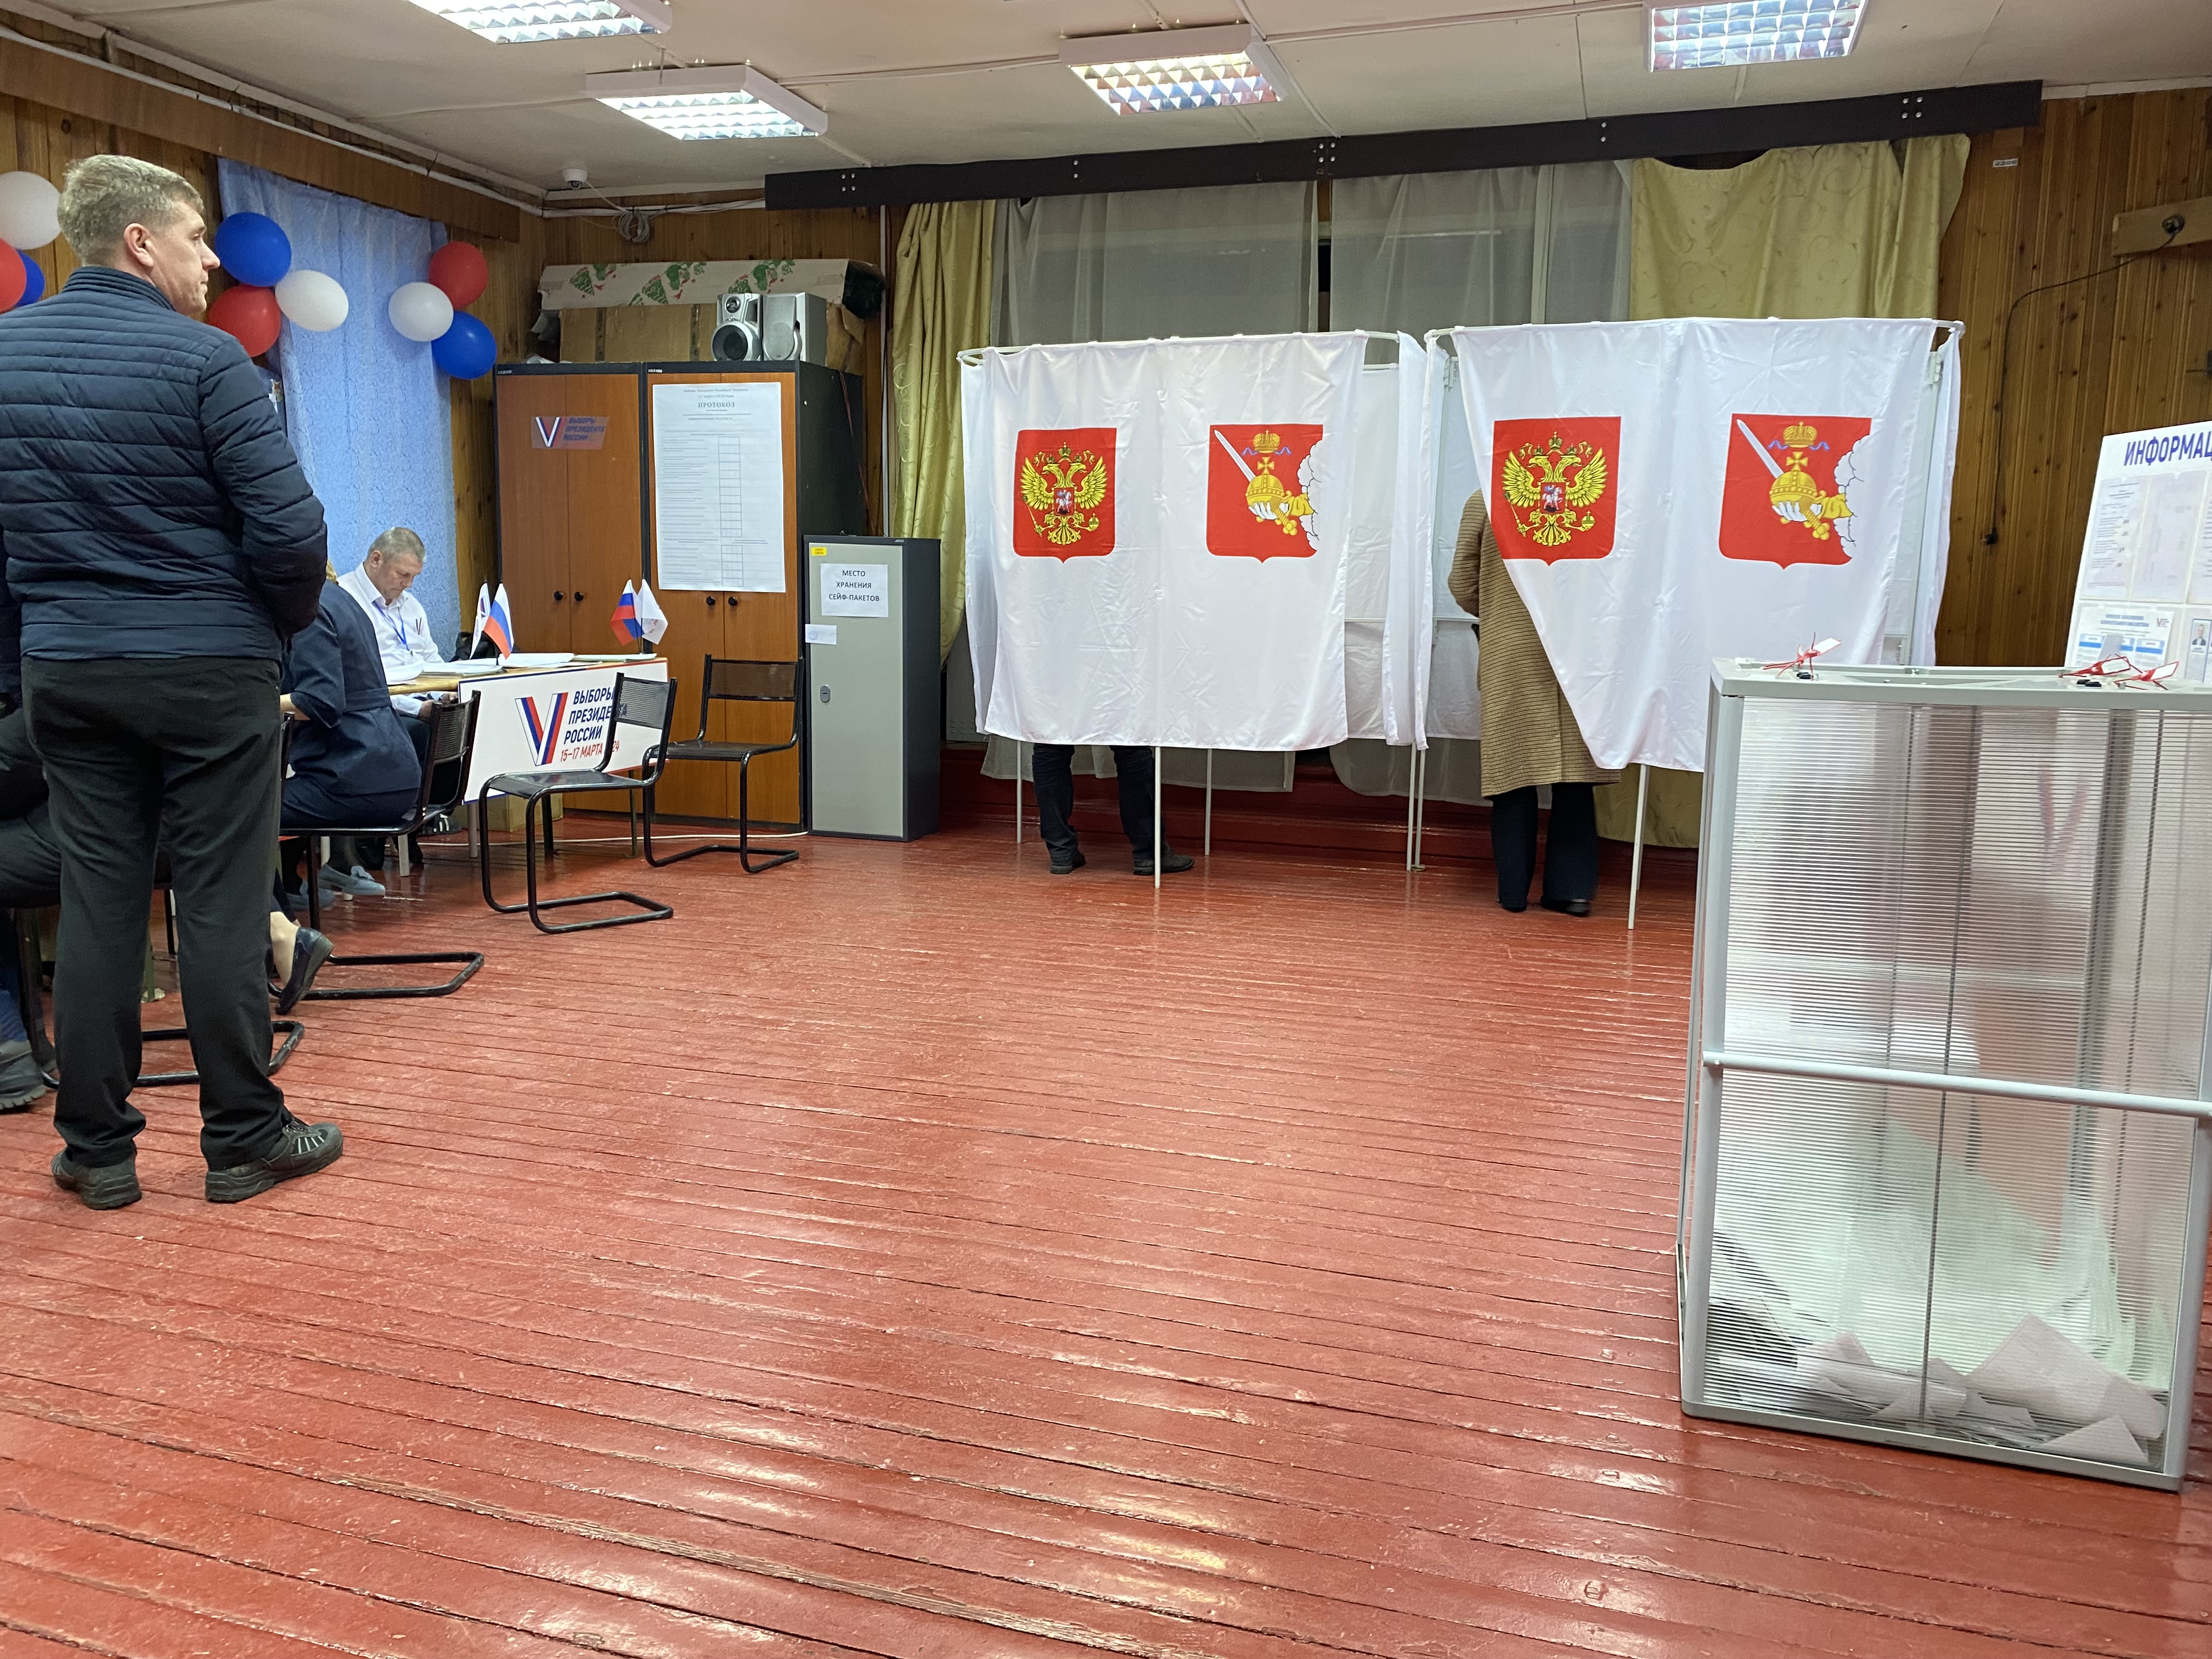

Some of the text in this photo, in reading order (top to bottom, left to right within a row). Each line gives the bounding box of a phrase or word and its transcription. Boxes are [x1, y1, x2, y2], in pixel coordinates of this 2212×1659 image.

[828, 593, 879, 602] СЕЙФ-ПАКЕТОВ
[573, 686, 615, 705] ВЫБОРЫ
[563, 725, 603, 744] РОССИИ
[579, 743, 603, 759] МАРТА
[612, 740, 620, 753] 24
